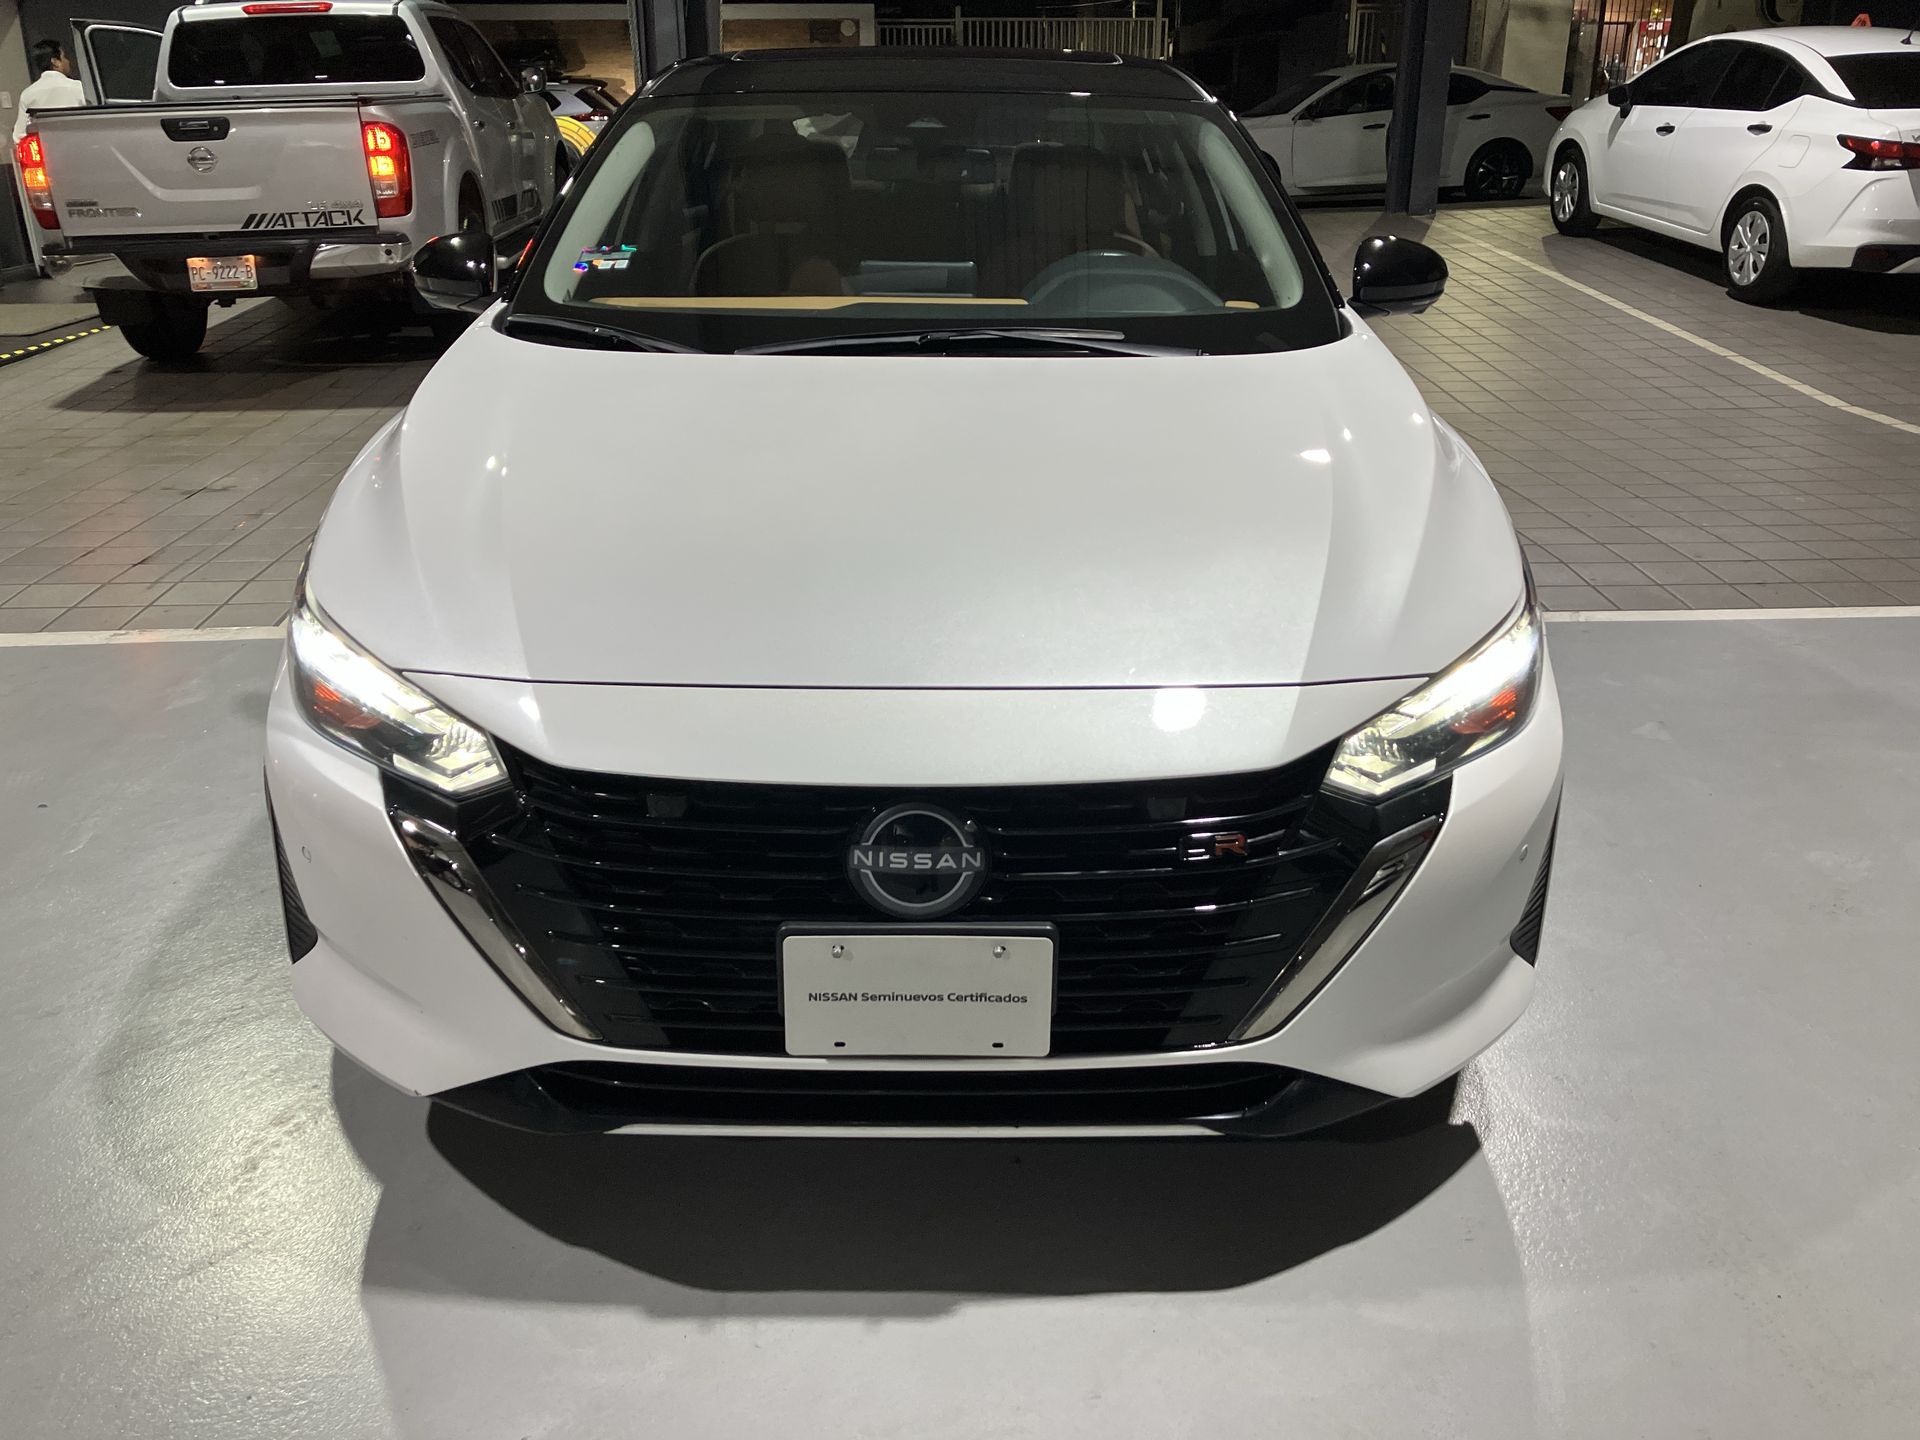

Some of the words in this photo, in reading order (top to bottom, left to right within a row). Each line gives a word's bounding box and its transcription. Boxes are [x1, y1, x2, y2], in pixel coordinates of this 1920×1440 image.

[191, 264, 254, 281] PC-9222-B
[853, 849, 981, 870] NISSAN
[808, 992, 858, 1002] NISSAN
[861, 991, 944, 1002] Seminuevos
[947, 992, 1028, 1004] Certificados
